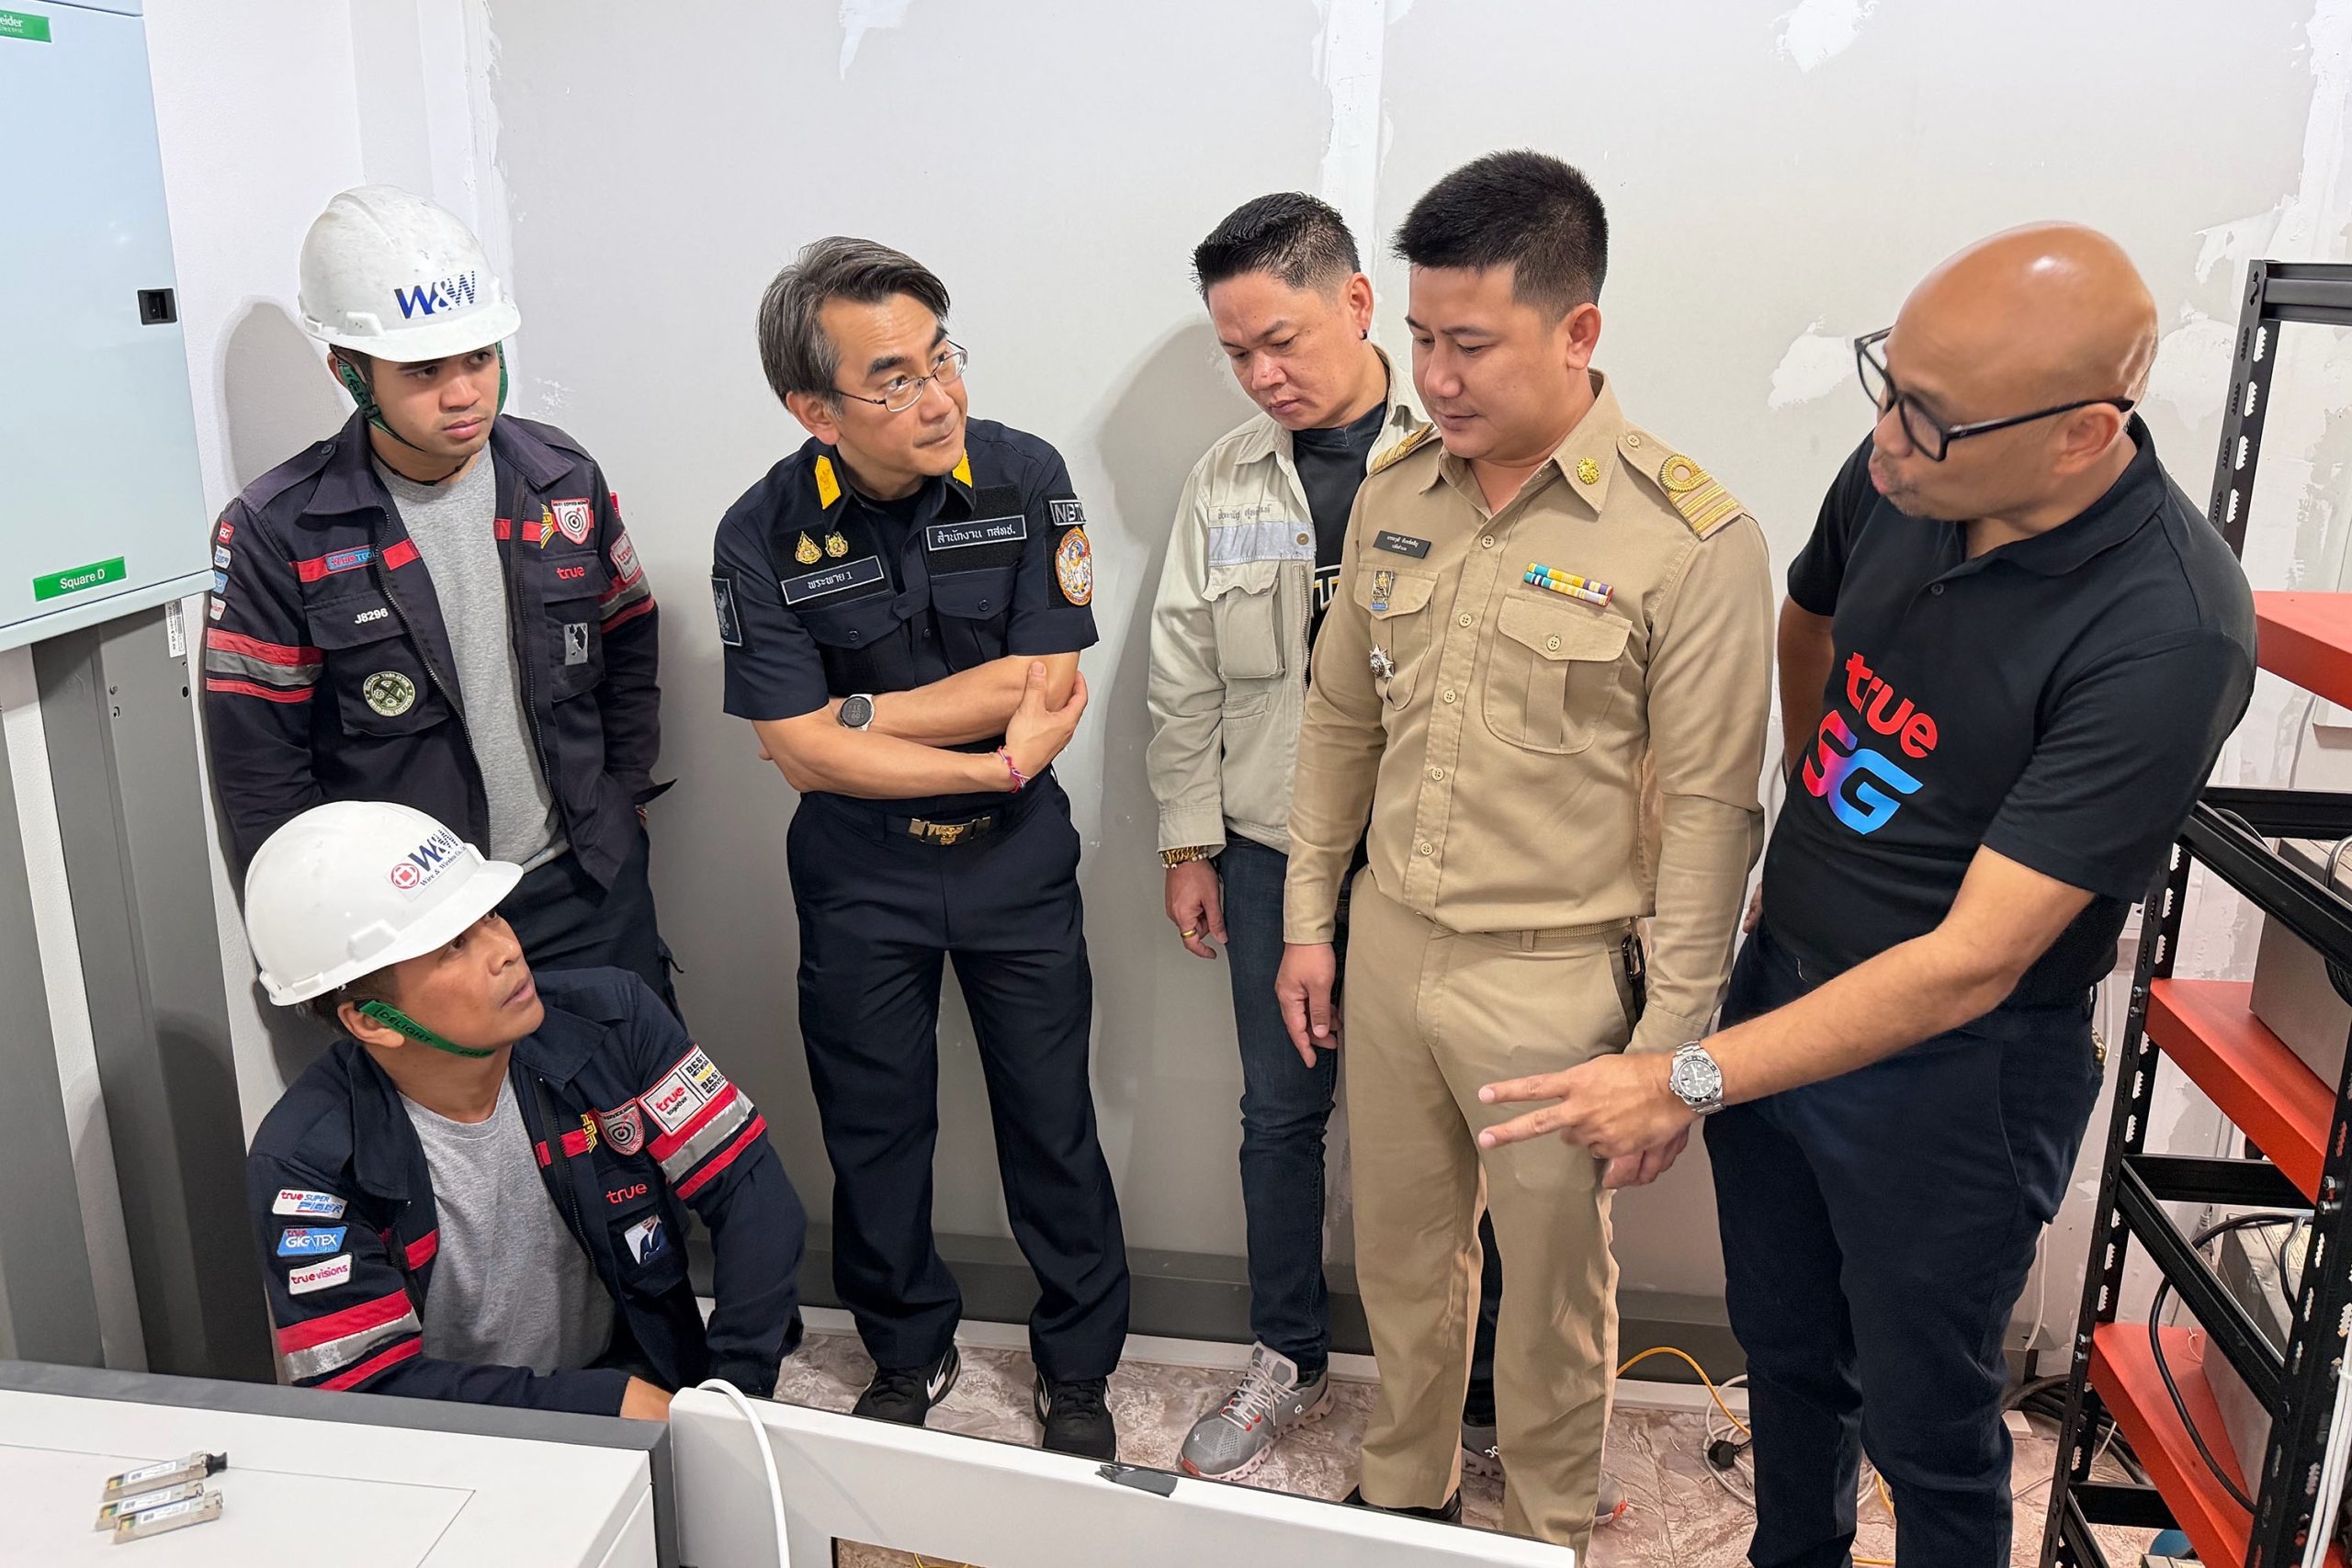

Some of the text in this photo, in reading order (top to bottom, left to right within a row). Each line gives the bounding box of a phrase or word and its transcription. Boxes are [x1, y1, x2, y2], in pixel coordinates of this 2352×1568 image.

[393, 270, 475, 320] W&W
[937, 524, 1016, 544] สำนักงาน กสทช.
[60, 568, 106, 590] Square D
[557, 566, 585, 580] true
[355, 607, 389, 625] J8296
[1845, 651, 1939, 759] true
[1802, 709, 1925, 836] 5G
[655, 1087, 685, 1112] true
[666, 1096, 688, 1116] together
[280, 1190, 331, 1203] true SUPER
[605, 1182, 649, 1205] true
